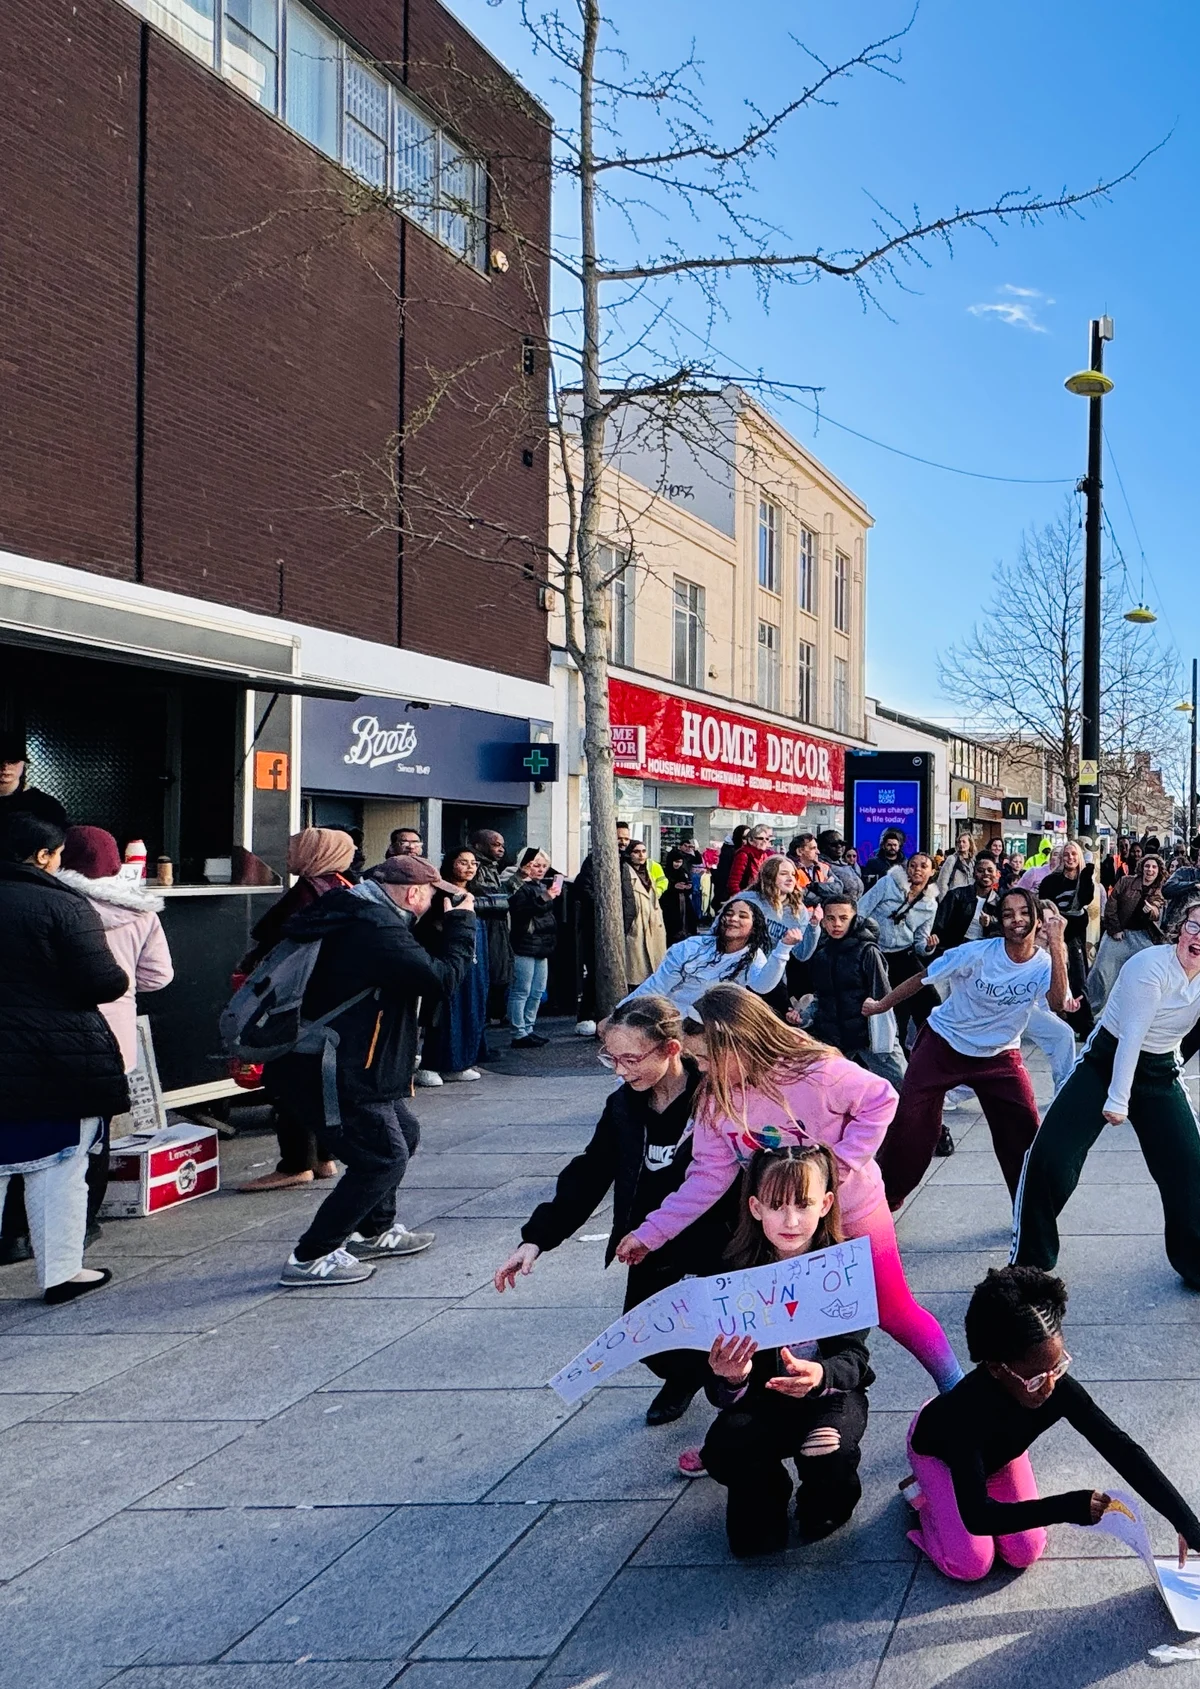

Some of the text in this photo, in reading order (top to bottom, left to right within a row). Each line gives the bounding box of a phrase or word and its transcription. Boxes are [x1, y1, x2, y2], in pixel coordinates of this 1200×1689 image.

[344, 716, 417, 768] Boots
[611, 729, 634, 740] ME
[682, 710, 830, 782] HOME DECOR
[397, 763, 430, 775] Since 1849
[648, 758, 695, 779] HOUSEWARE
[700, 767, 745, 787] KITCHENWARE
[885, 816, 905, 824] today
[887, 807, 914, 815] change
[975, 979, 1039, 997] CHICAGO
[712, 1284, 795, 1316] TOWN
[823, 1263, 858, 1293] OF
